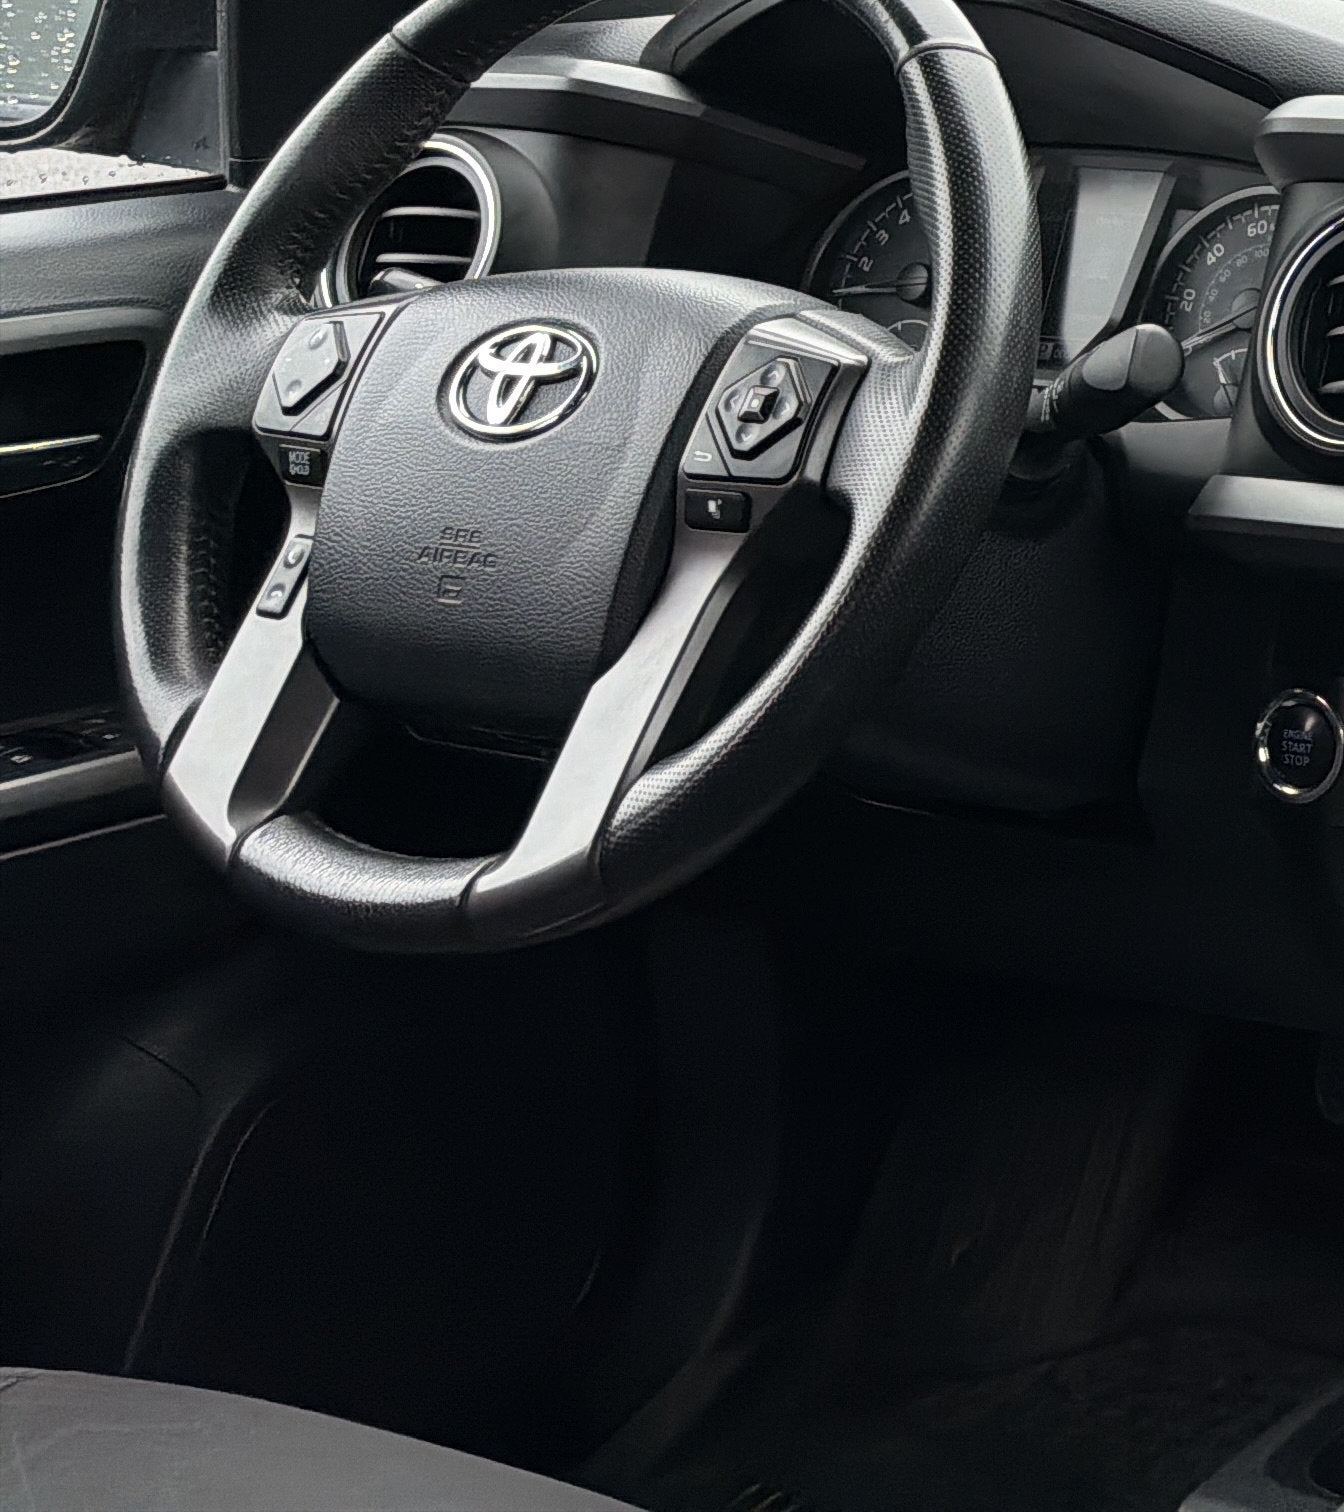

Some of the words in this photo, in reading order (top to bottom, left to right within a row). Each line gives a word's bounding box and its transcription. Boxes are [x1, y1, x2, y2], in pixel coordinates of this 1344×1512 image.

[899, 208, 911, 225] 4
[1247, 220, 1268, 237] 60
[875, 229, 889, 246] 3
[1206, 243, 1225, 266] 40
[858, 256, 873, 272] 2
[1180, 288, 1196, 312] 20
[418, 546, 498, 567] AIRBAG
[1281, 740, 1313, 753] START
[1283, 753, 1310, 767] STOP
